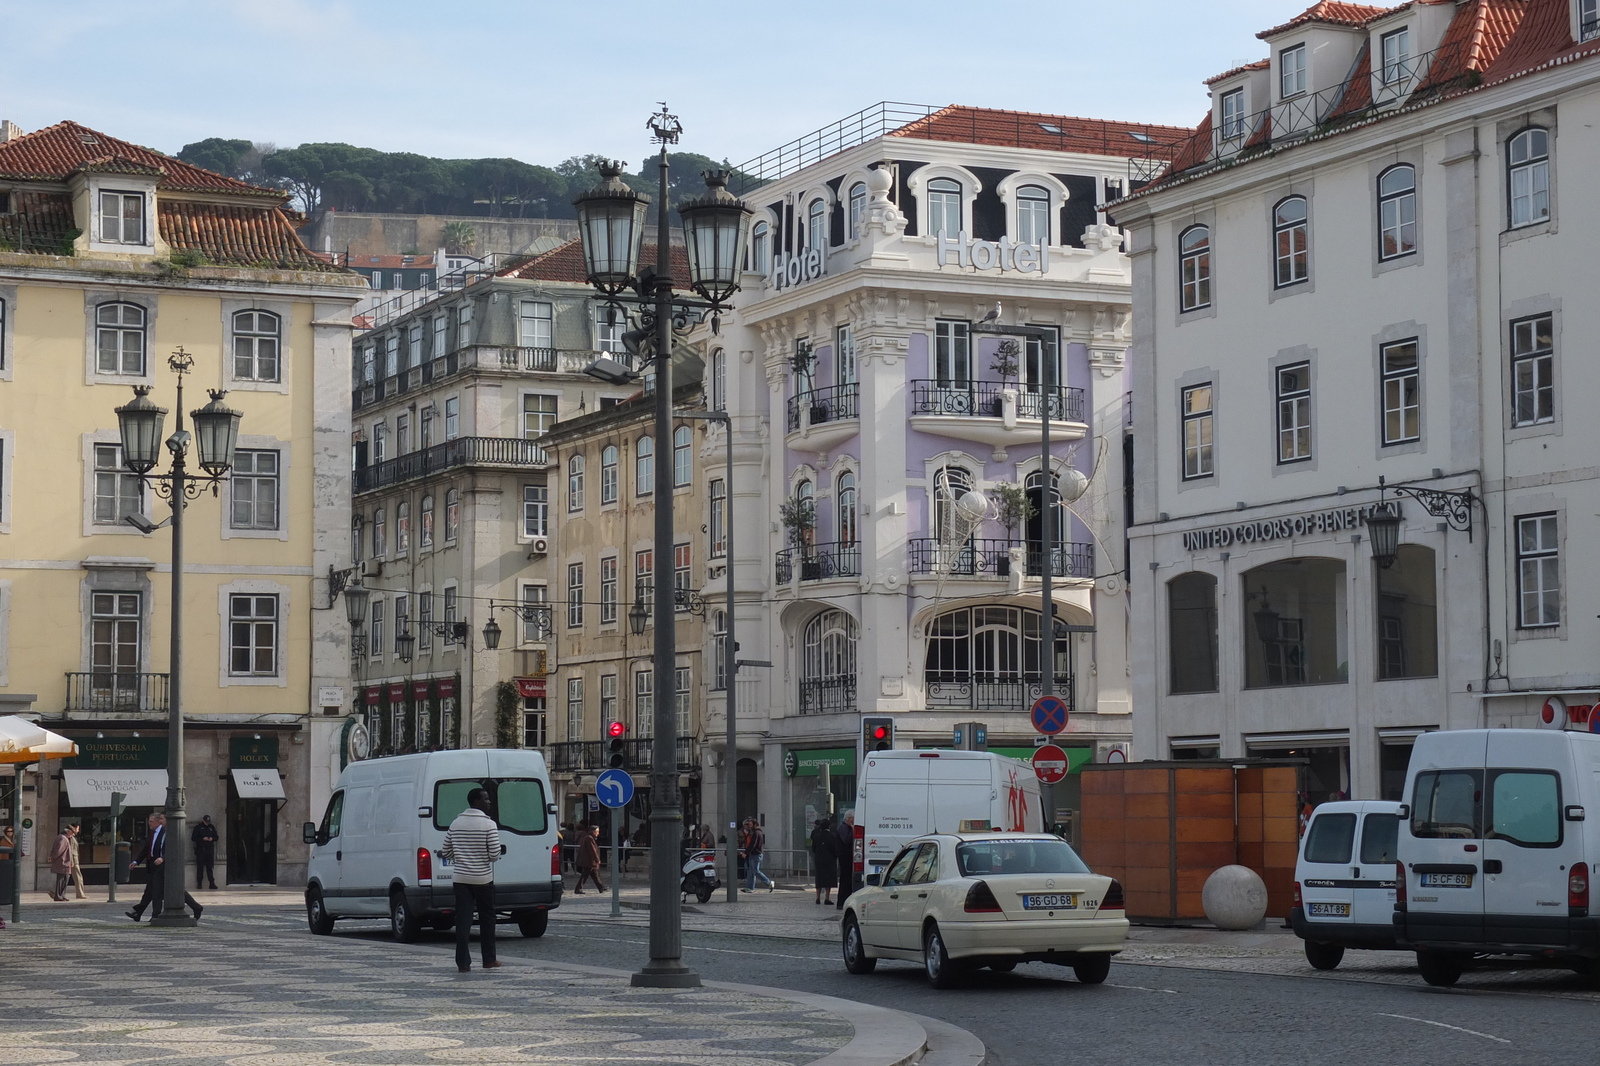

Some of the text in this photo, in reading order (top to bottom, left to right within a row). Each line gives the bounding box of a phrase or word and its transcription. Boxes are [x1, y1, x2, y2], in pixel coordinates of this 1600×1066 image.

[937, 229, 1049, 273] Hotel
[773, 237, 828, 290] Hotel
[1183, 526, 1232, 550] UNITED
[1234, 518, 1291, 543] COLORS
[1293, 515, 1315, 535] OF
[85, 743, 147, 752] OURIVESARIA
[92, 753, 141, 761] PORTUGAL
[86, 778, 150, 787] OURIVESARIA
